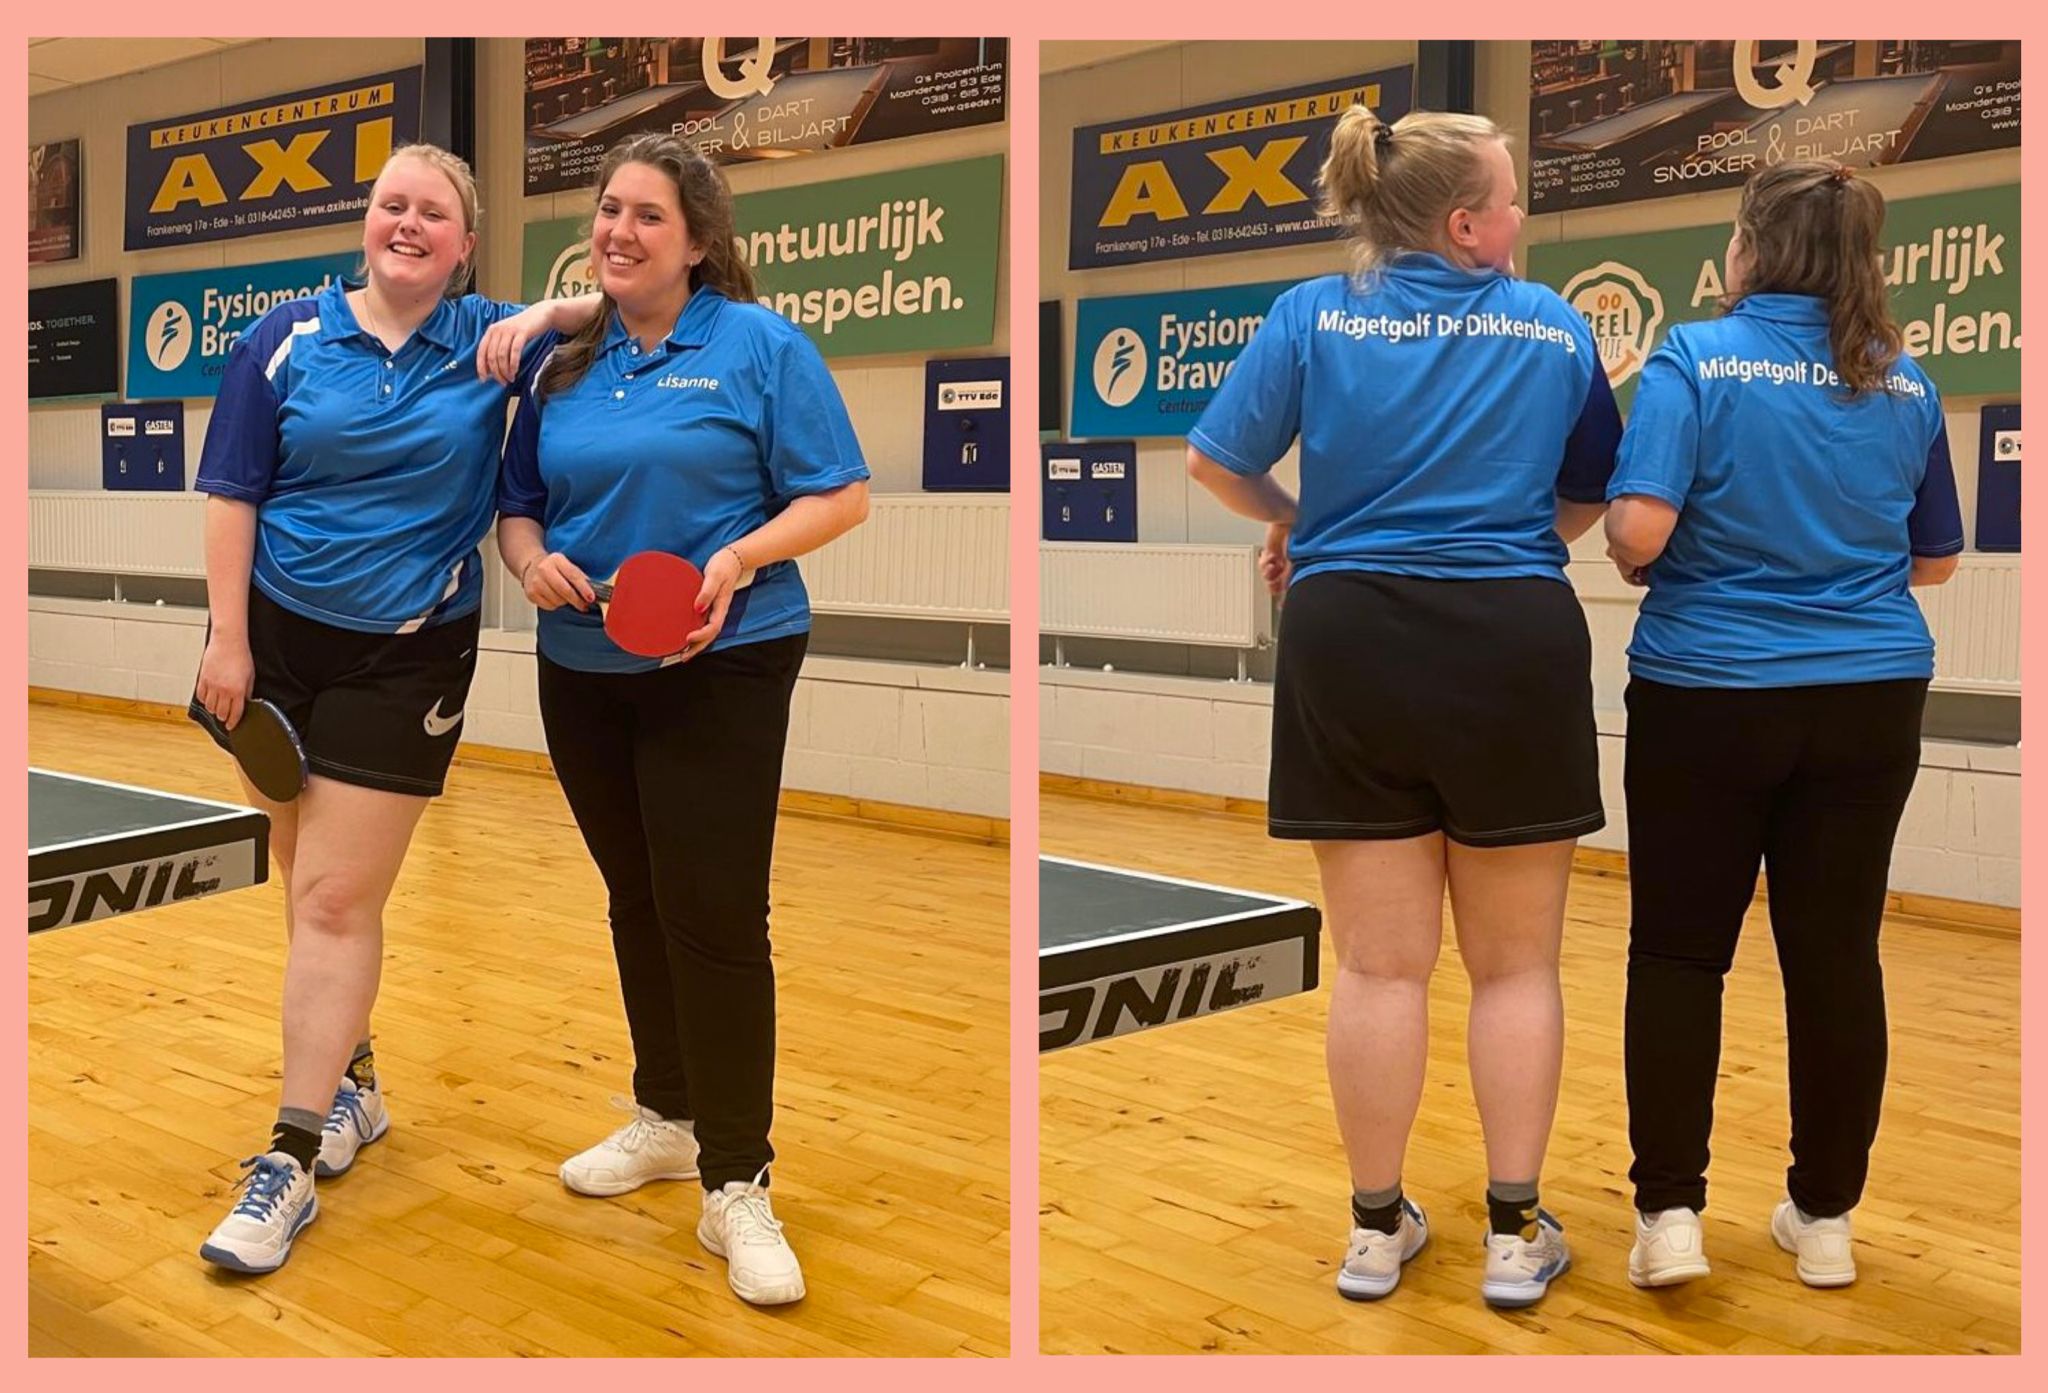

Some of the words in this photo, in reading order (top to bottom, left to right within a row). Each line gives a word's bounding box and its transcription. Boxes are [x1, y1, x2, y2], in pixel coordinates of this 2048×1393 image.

[934, 63, 1002, 80] Poolcentrum
[890, 81, 957, 99] Maandereind
[959, 77, 977, 87] 53
[980, 74, 1002, 84] Ede
[160, 88, 381, 145] KEUKENCENTRUM
[757, 98, 815, 122] DART
[1112, 90, 1367, 150] KEUKENCENTRUM
[1795, 109, 1860, 136] DART
[671, 117, 724, 137] POOL
[757, 115, 852, 146] BILJART
[1697, 130, 1758, 153] POOL
[1794, 130, 1902, 160] BILJART
[149, 116, 394, 213] AXI
[1653, 154, 1756, 184] SNOOKER
[147, 220, 193, 238] Frankeneng
[213, 217, 229, 229] Ede
[1095, 236, 1148, 255] Frankeneng
[1172, 234, 1190, 246] Ede
[1466, 312, 1577, 353] Dikkenberg
[1698, 354, 1808, 385] Midgetgolf
[1812, 364, 1839, 387] De
[958, 393, 977, 401] TTV
[979, 391, 999, 400] Ede
